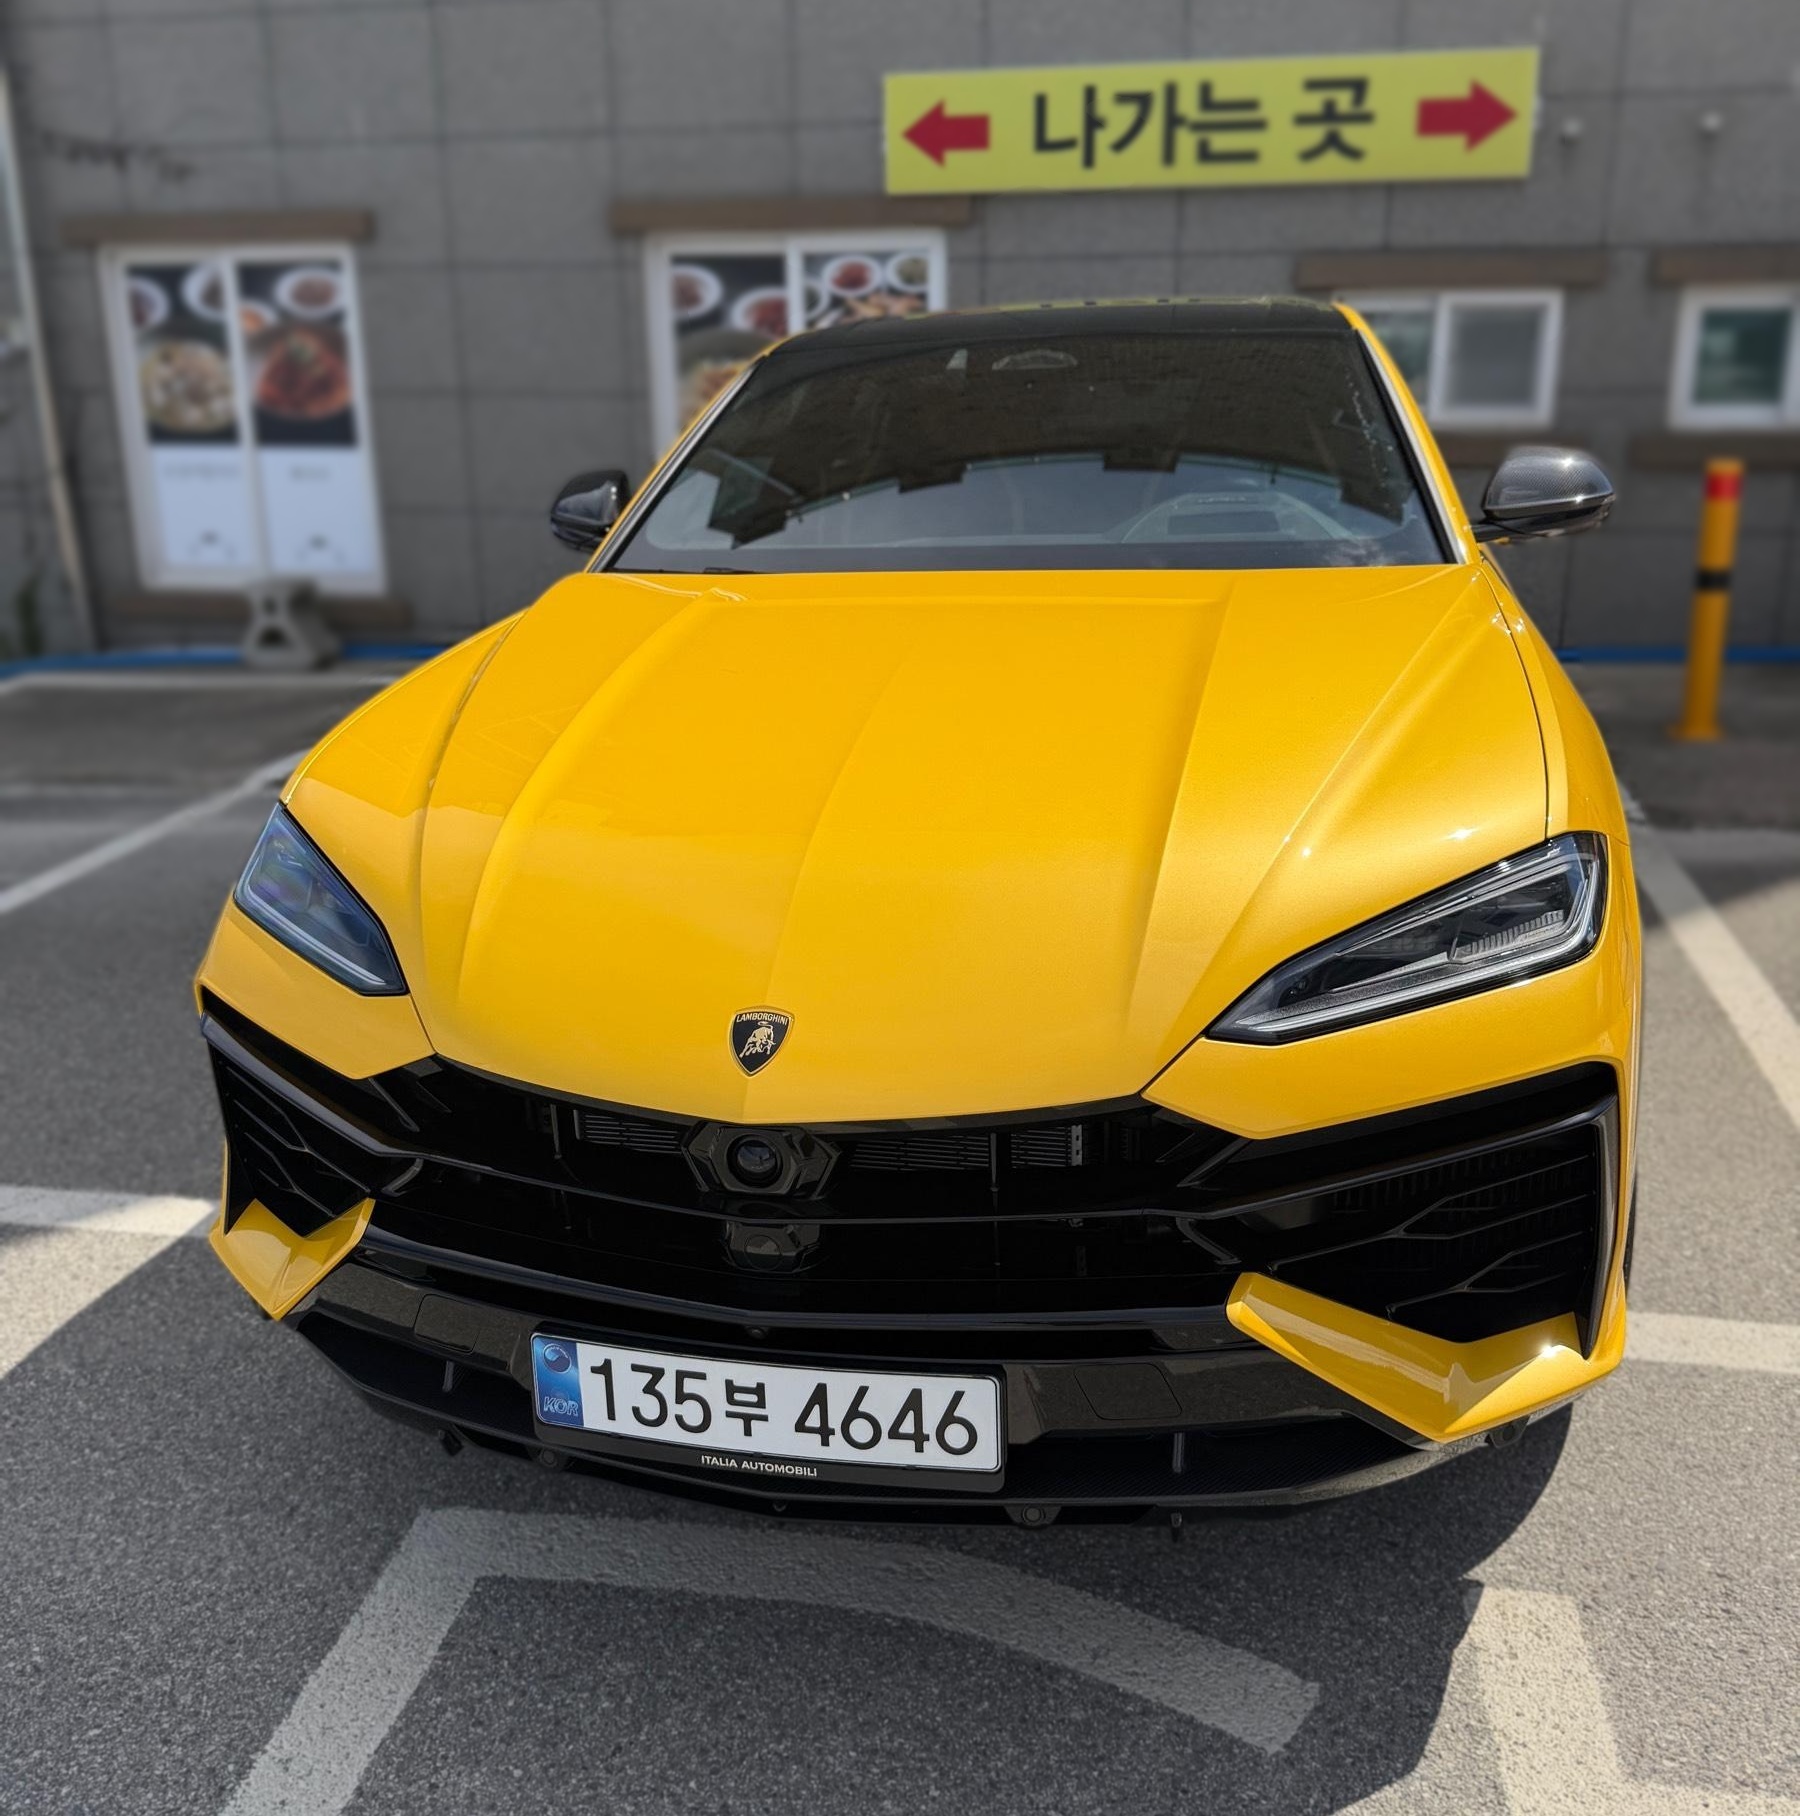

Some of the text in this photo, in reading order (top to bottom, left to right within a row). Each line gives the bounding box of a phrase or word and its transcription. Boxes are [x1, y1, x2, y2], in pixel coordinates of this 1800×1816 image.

[1033, 77, 1376, 169] 나가는 곳
[736, 1012, 788, 1025] LAMBORGHINI
[543, 1396, 579, 1417] KOR
[590, 1358, 979, 1456] 135부 4646
[701, 1454, 818, 1477] ITALIA AUTOMOBILI
